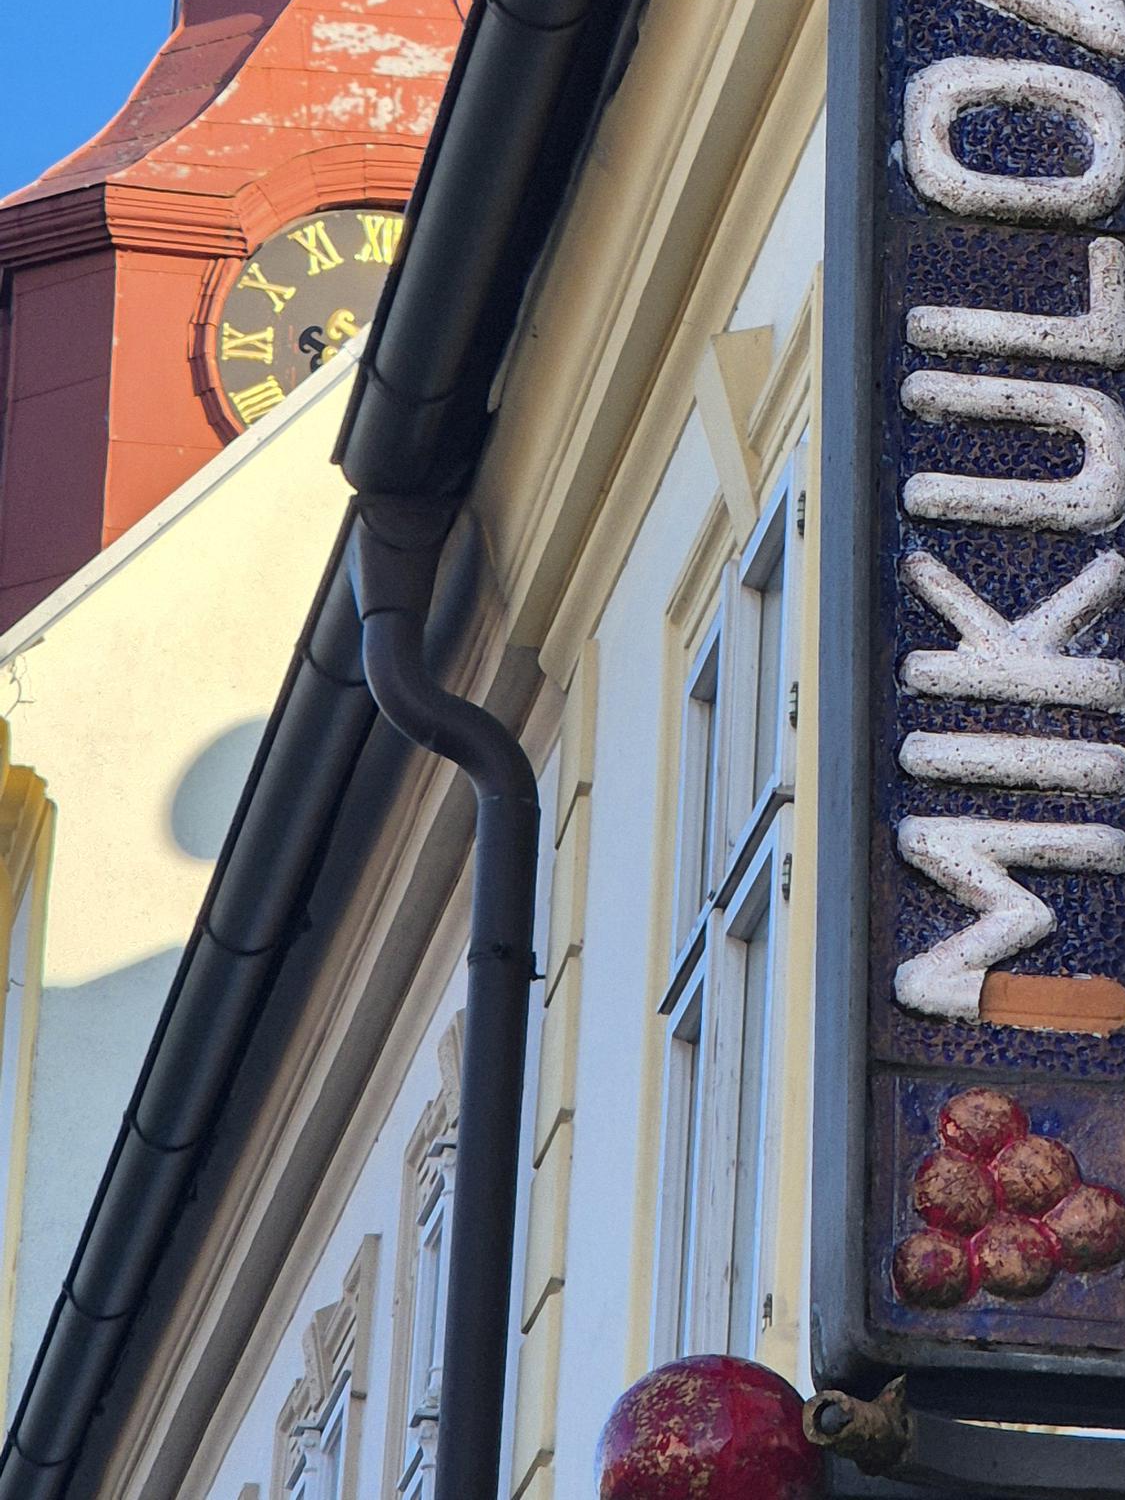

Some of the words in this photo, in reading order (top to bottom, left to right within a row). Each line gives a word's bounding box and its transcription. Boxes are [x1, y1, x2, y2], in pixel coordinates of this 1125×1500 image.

[286, 219, 345, 276] XI
[237, 262, 297, 314] X
[221, 321, 275, 365] IX
